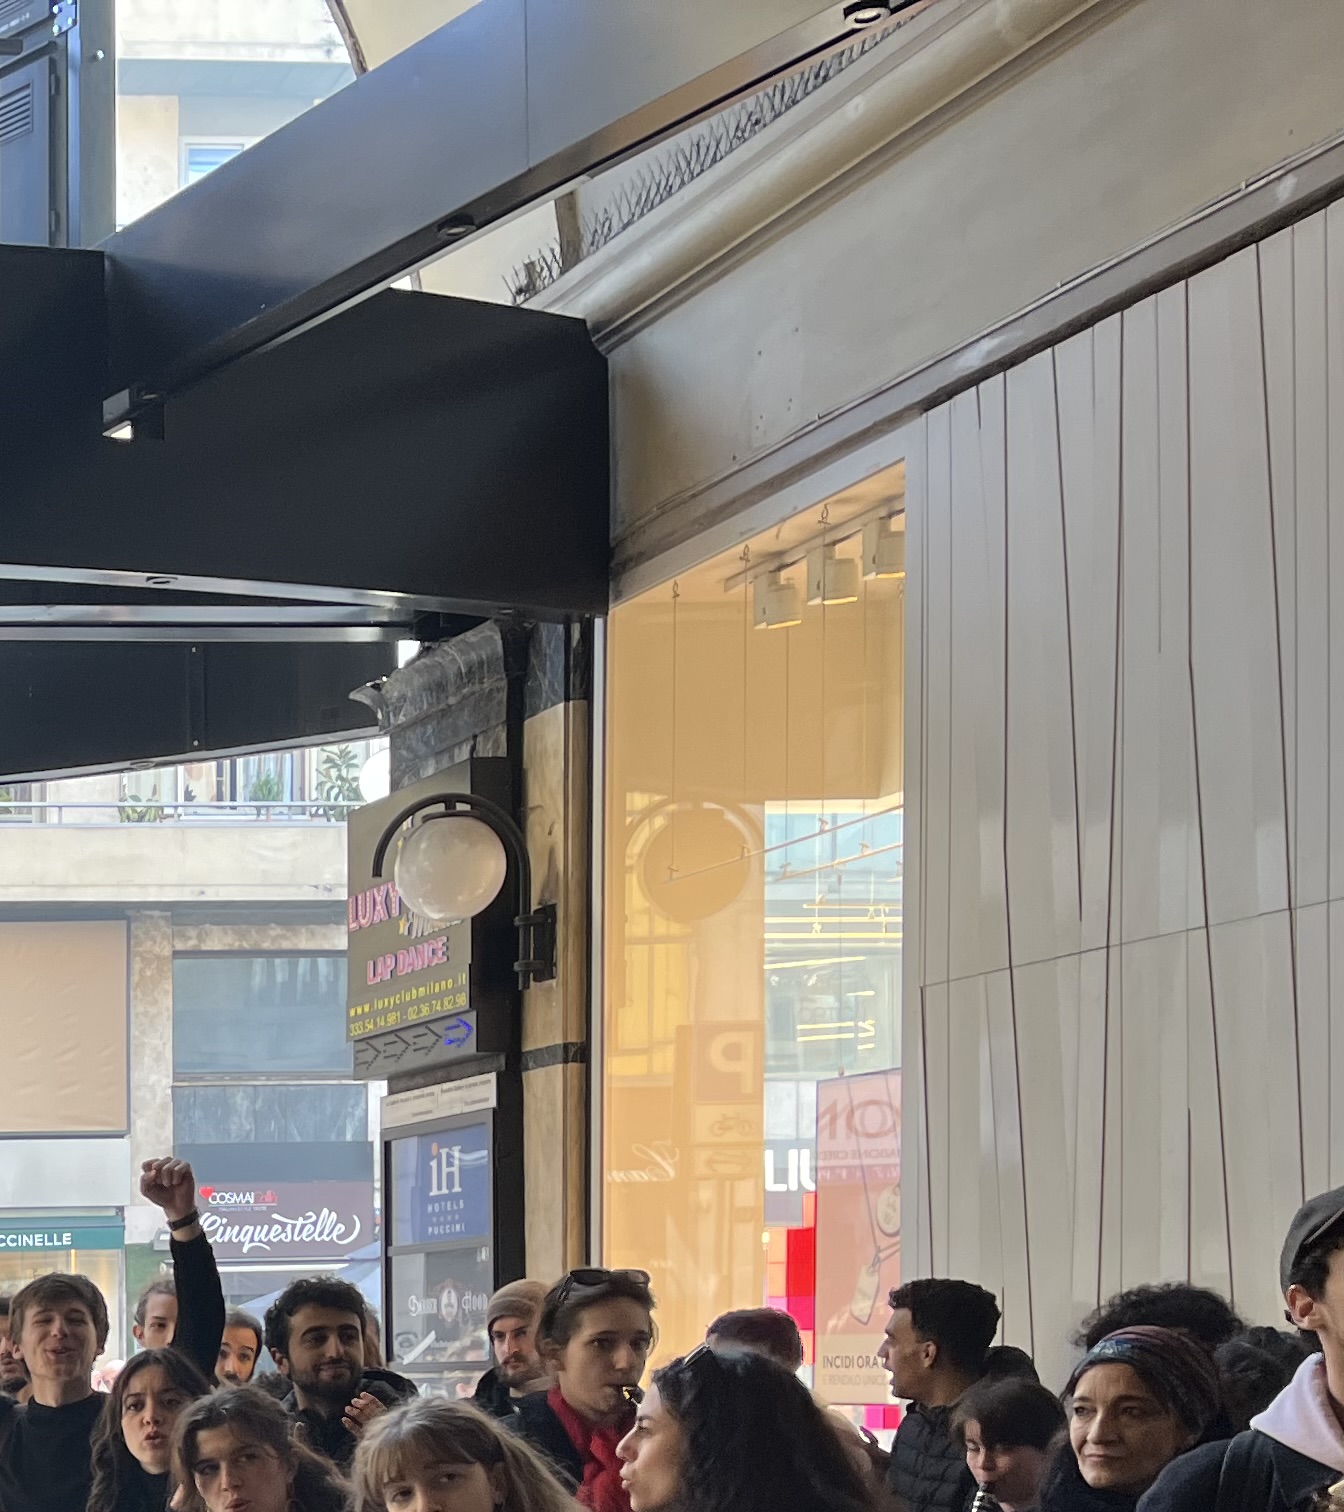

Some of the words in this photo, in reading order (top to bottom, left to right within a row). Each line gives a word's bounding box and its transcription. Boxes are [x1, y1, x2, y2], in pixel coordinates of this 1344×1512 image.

[348, 880, 402, 932] LUXY
[367, 953, 396, 985] LAP
[397, 936, 449, 976] DANCE
[349, 972, 467, 1017] www.luxyclubmilano.it
[429, 1142, 463, 1197] iH
[427, 1199, 465, 1214] HOTELS
[427, 1223, 466, 1236] PUCCINI
[199, 1207, 361, 1254] Cinquestelle
[822, 1355, 855, 1369] INCIDI
[856, 1355, 880, 1369] ORA
